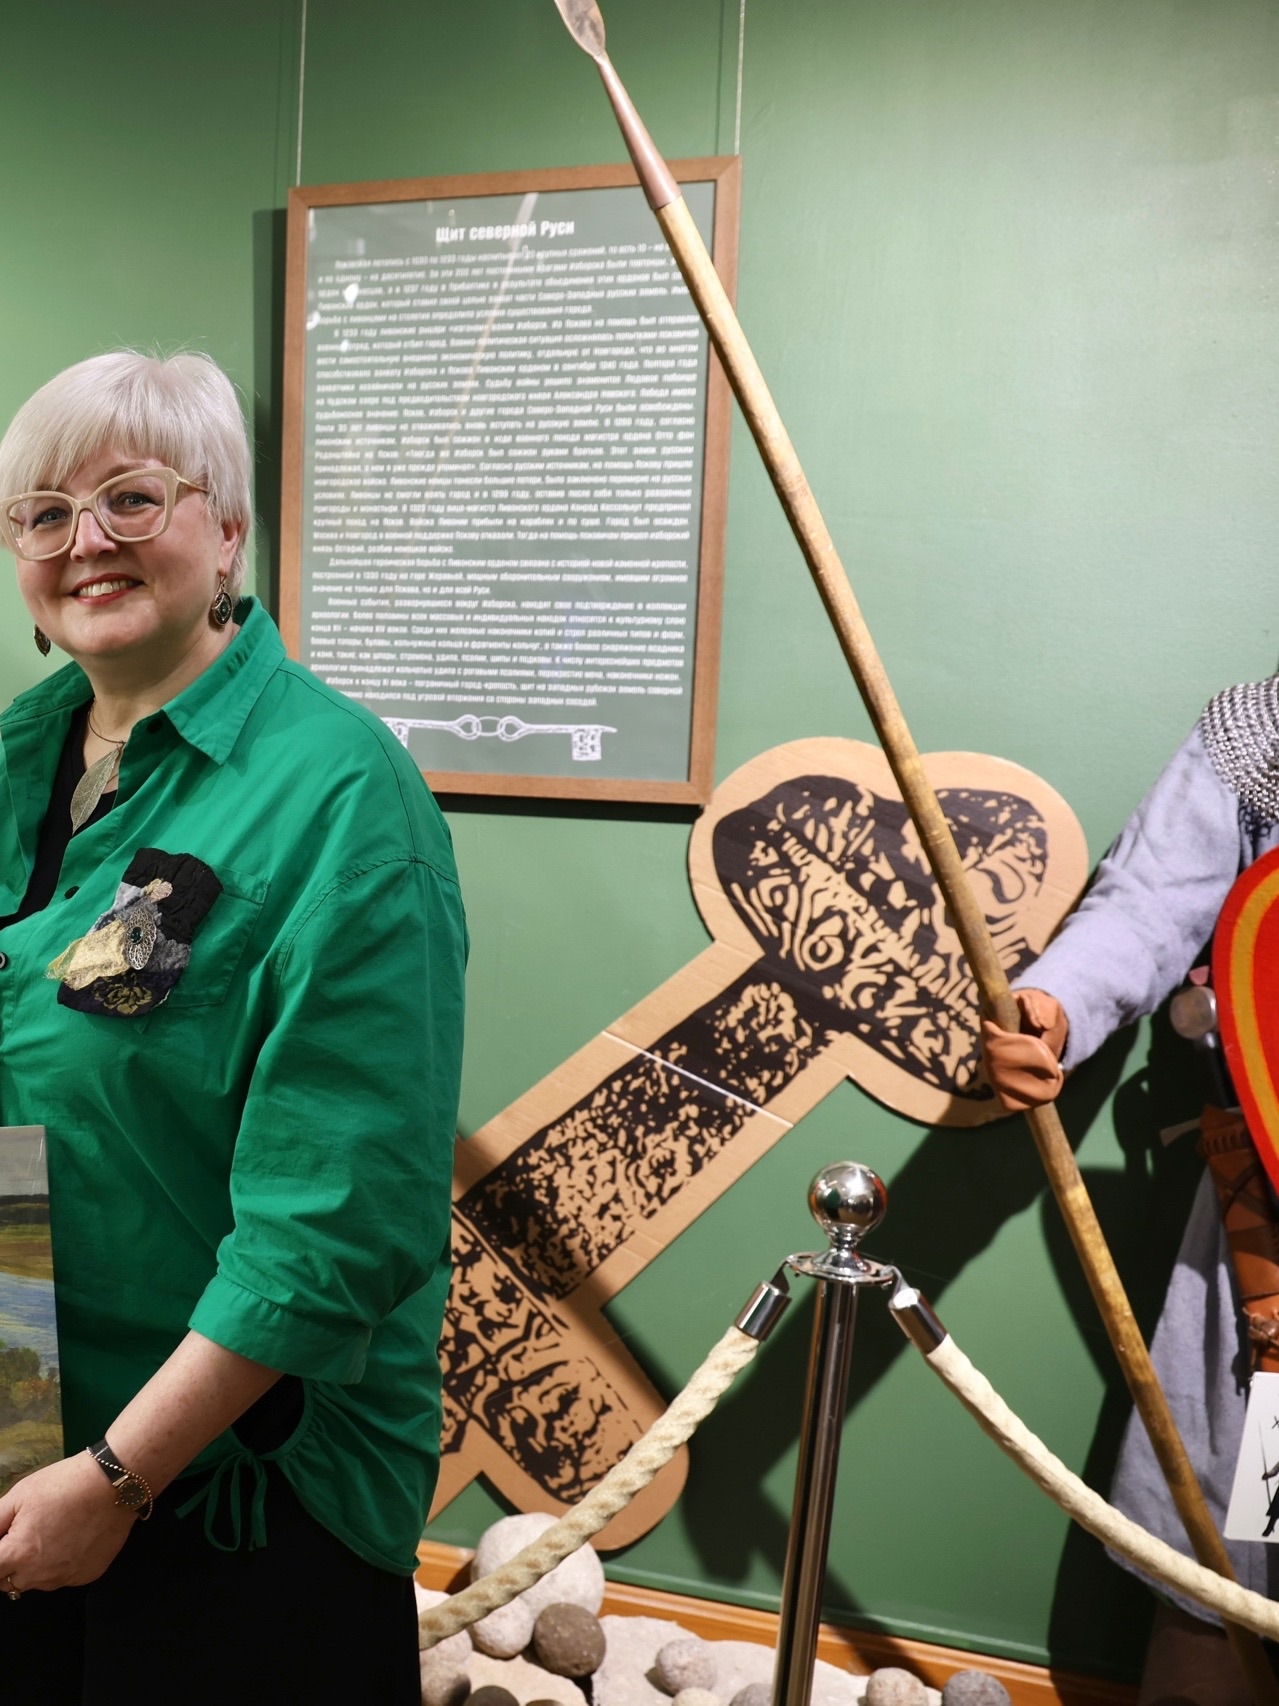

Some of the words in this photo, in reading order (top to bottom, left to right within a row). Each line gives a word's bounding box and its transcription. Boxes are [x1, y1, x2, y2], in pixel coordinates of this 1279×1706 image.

[436, 227, 465, 242] Щит
[470, 222, 536, 241] северной
[541, 220, 575, 238] Руси
